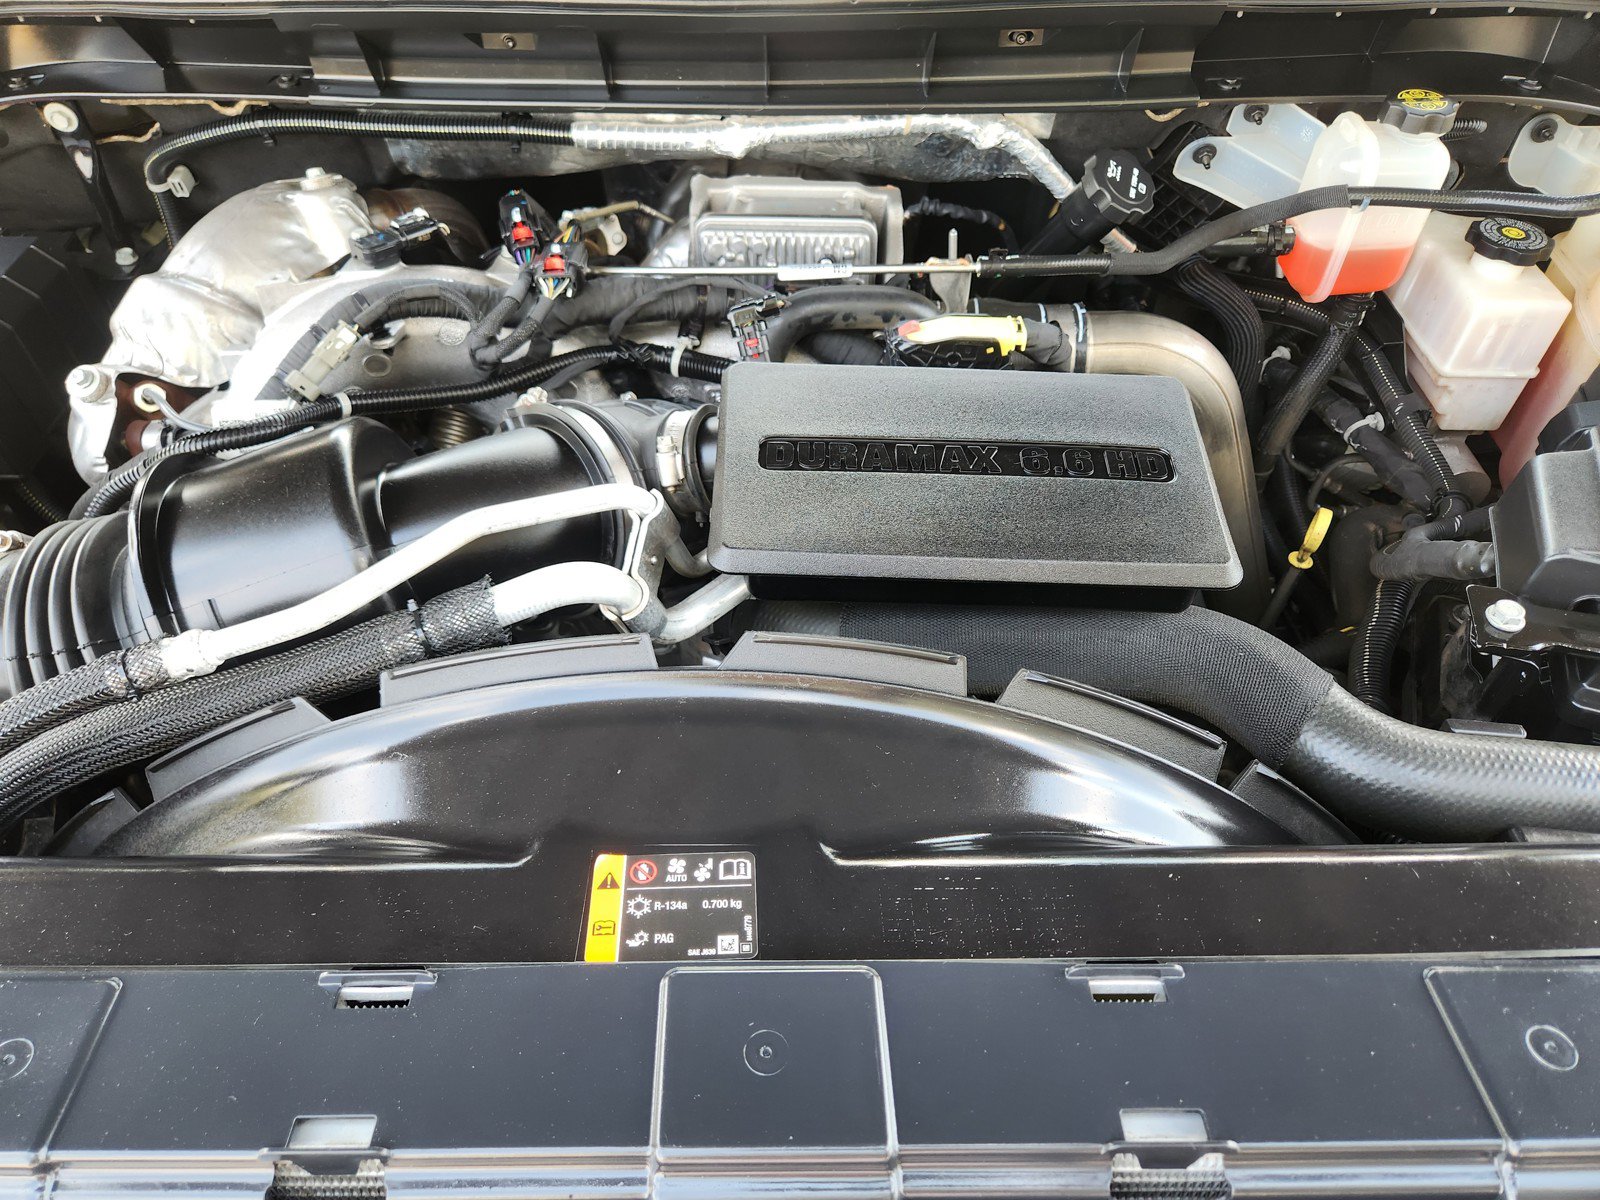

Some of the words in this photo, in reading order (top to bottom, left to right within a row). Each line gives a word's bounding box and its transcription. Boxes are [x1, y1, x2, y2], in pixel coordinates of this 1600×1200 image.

[765, 441, 1002, 473] DURAMAX
[1019, 447, 1095, 477] 6.6
[1103, 450, 1169, 480] HD
[665, 874, 688, 883] AUTO
[654, 901, 688, 911] R-134a
[702, 899, 728, 909] 0.700
[730, 898, 742, 910] kg
[654, 933, 674, 944] PAG
[687, 948, 700, 956] SAE
